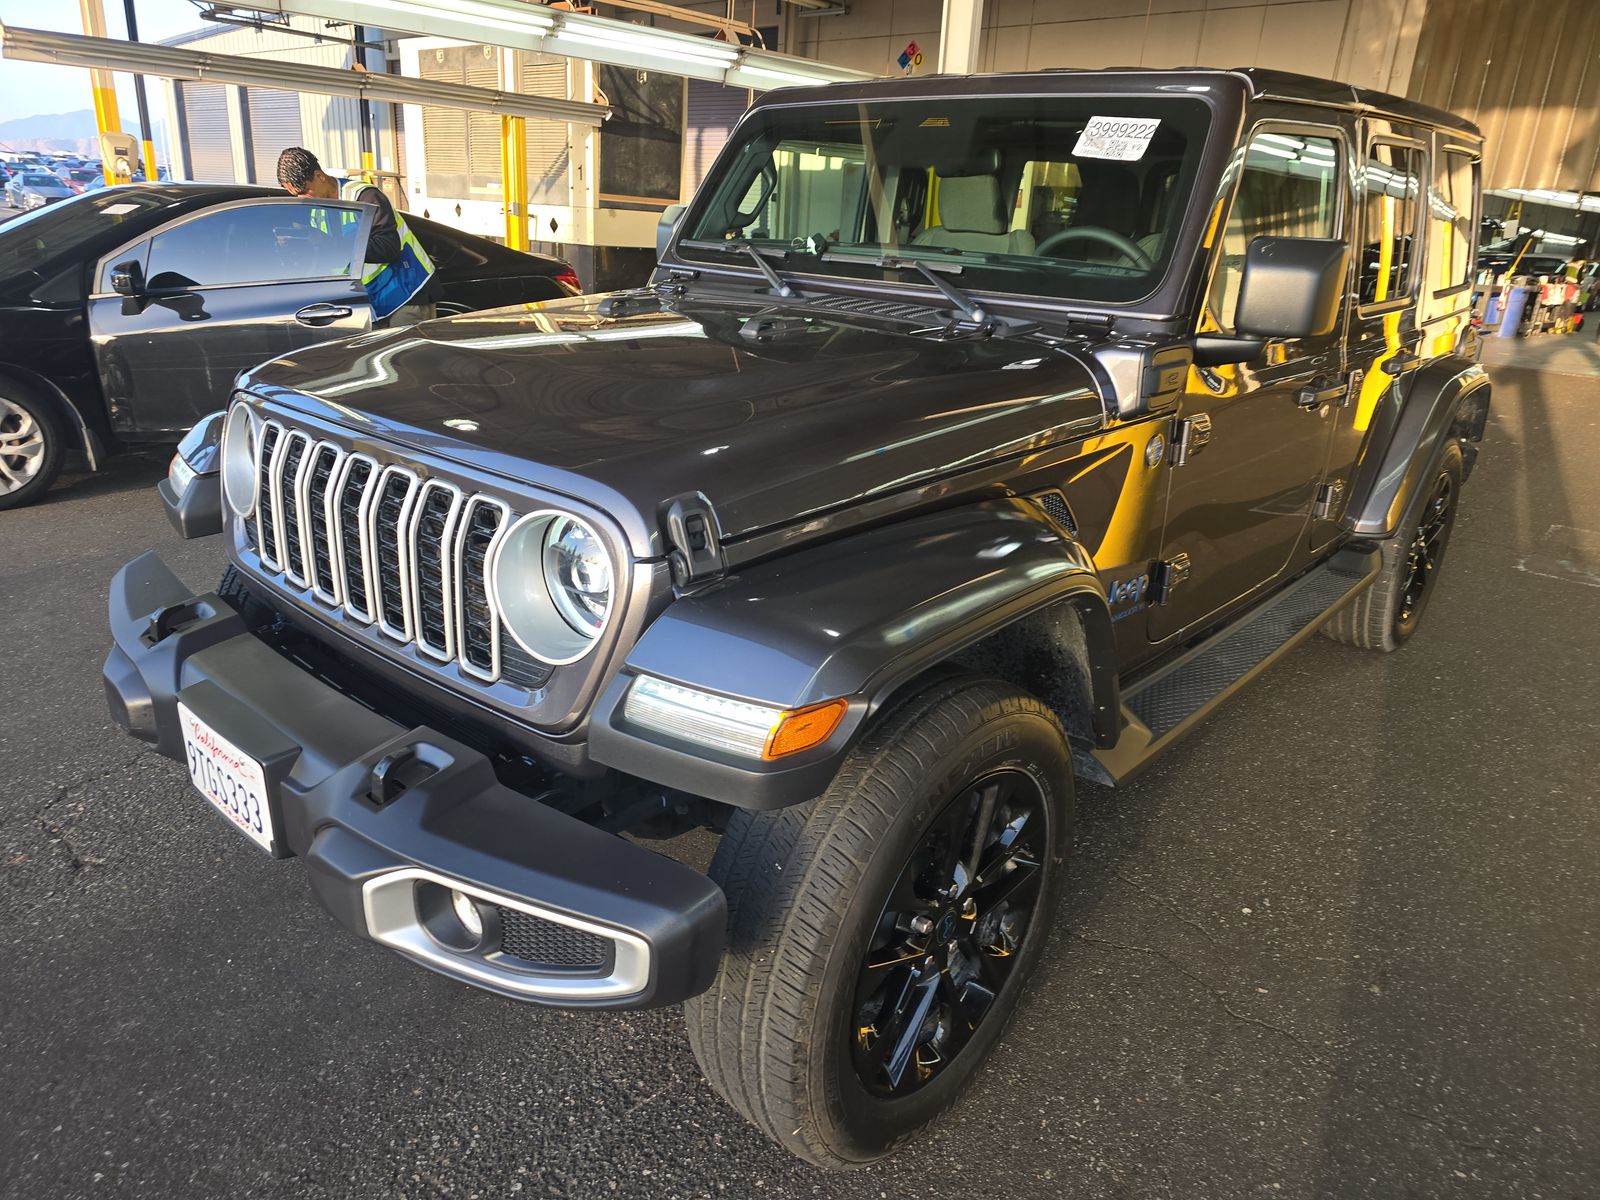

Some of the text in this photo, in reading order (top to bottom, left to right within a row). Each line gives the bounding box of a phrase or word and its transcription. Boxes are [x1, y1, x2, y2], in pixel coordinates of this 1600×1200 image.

[1090, 121, 1157, 139] 3999222
[577, 164, 583, 180] 1
[1107, 574, 1149, 606] Jeep
[193, 722, 246, 774] California
[187, 740, 263, 834] 9TGS333
